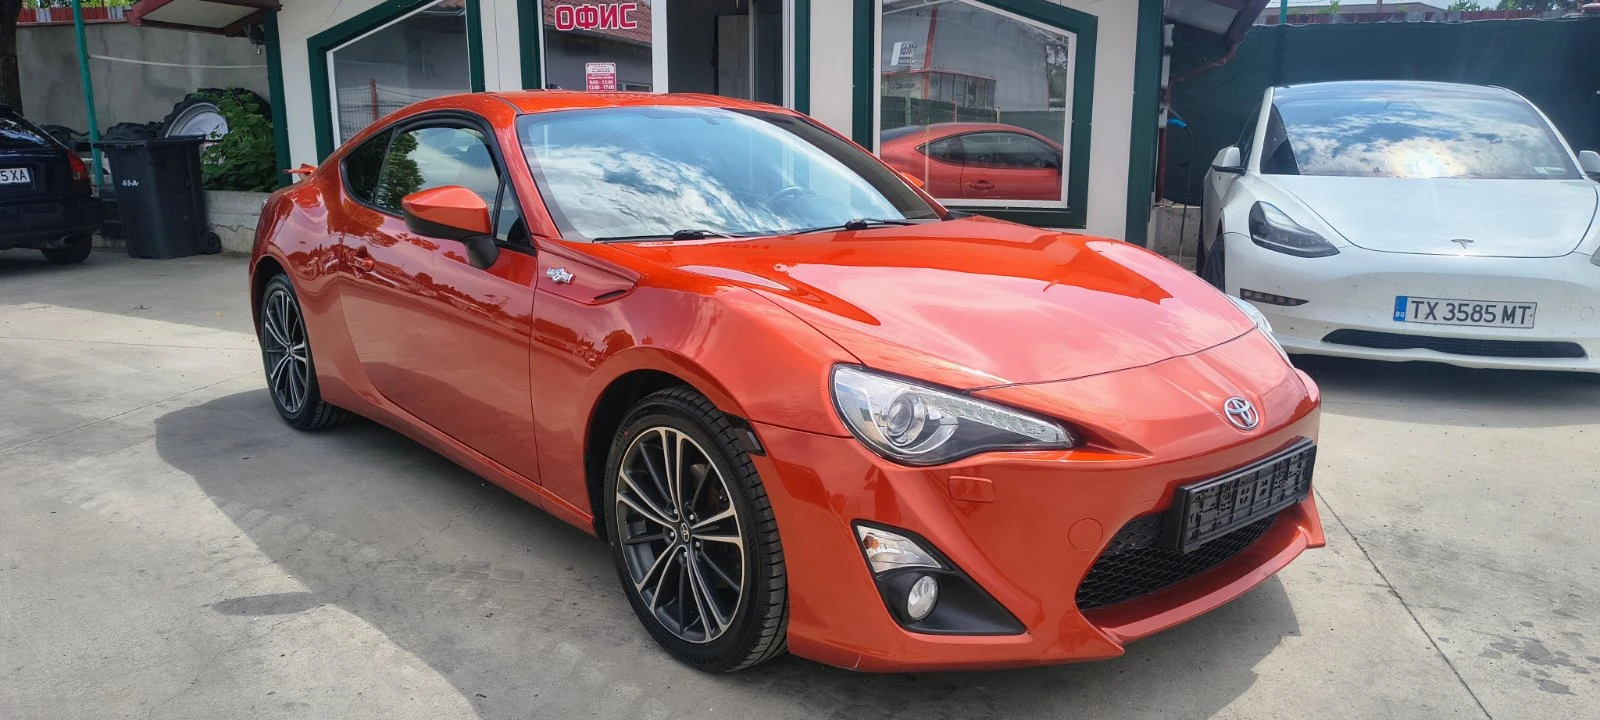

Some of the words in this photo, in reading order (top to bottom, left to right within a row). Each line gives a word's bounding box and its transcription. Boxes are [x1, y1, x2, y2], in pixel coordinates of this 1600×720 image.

[555, 3, 637, 31] ОФИС
[10, 169, 28, 181] XA
[1411, 300, 1440, 320] TX
[1442, 302, 1497, 323] 3585
[1501, 305, 1532, 325] MT
